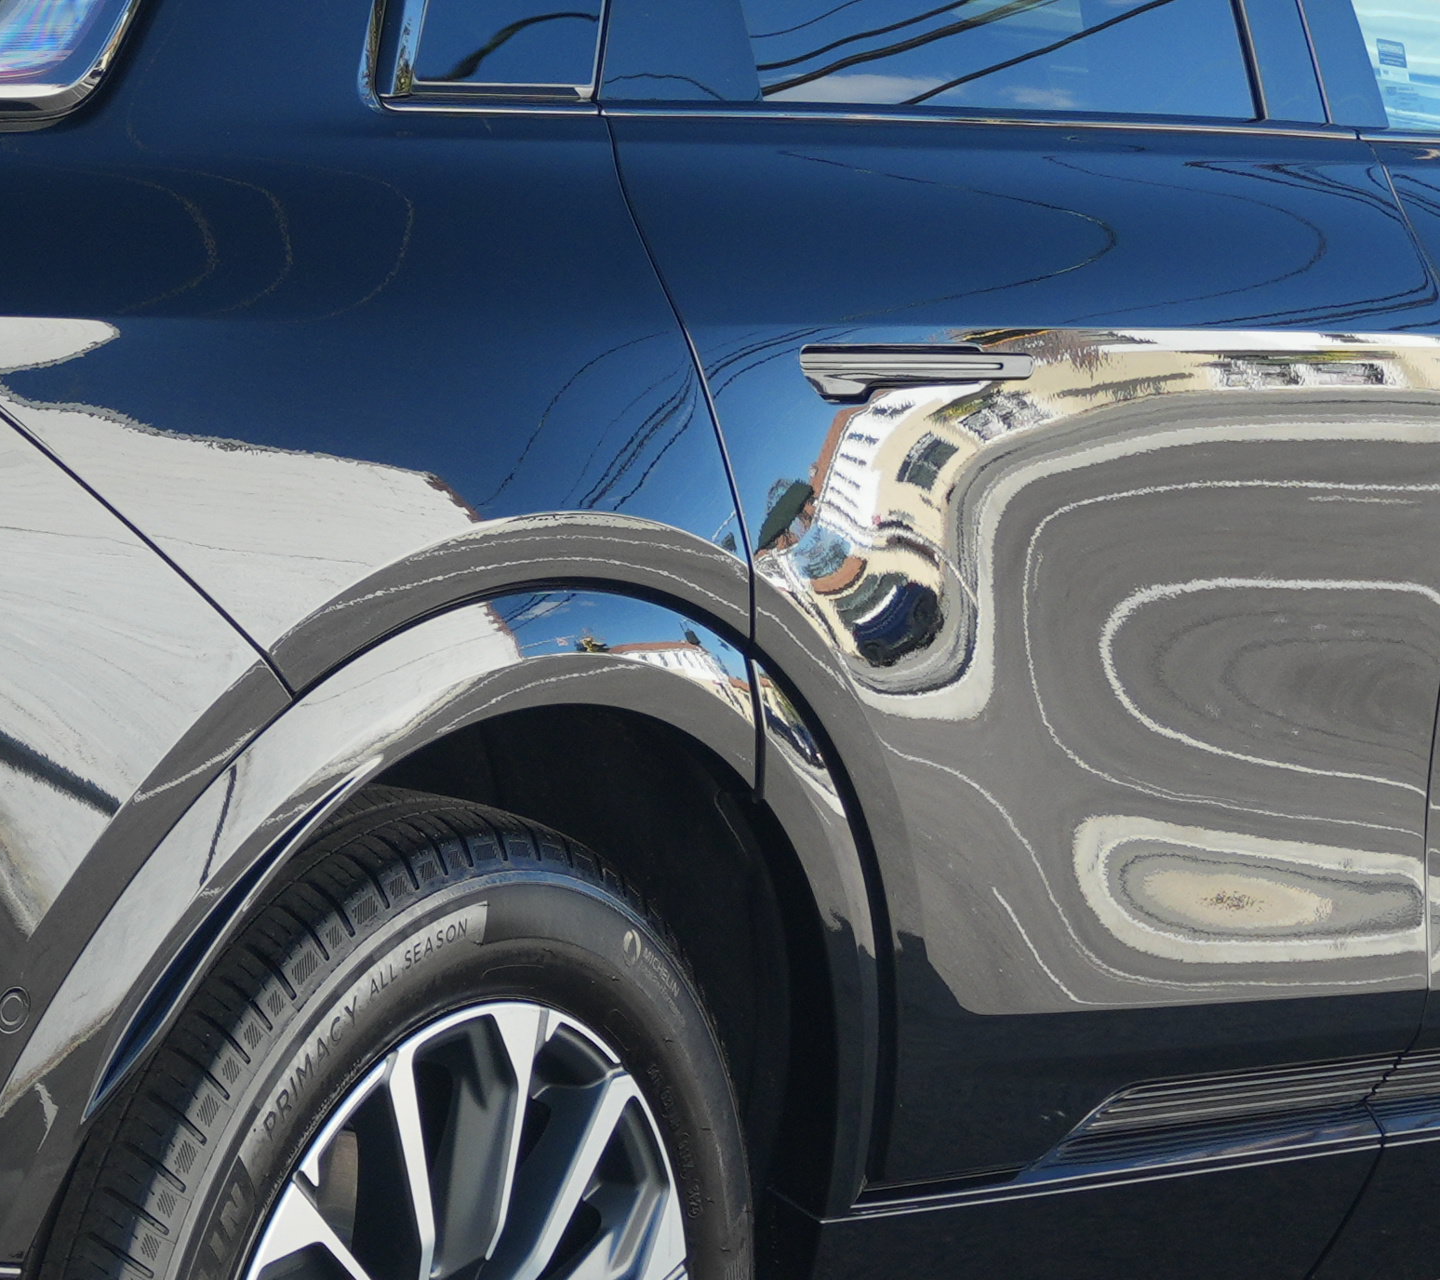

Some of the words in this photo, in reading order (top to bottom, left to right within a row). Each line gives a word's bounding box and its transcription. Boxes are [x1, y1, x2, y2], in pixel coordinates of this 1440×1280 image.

[263, 995, 358, 1140] PRIMACY
[369, 964, 399, 996] ALL
[404, 917, 469, 970] SEASON
